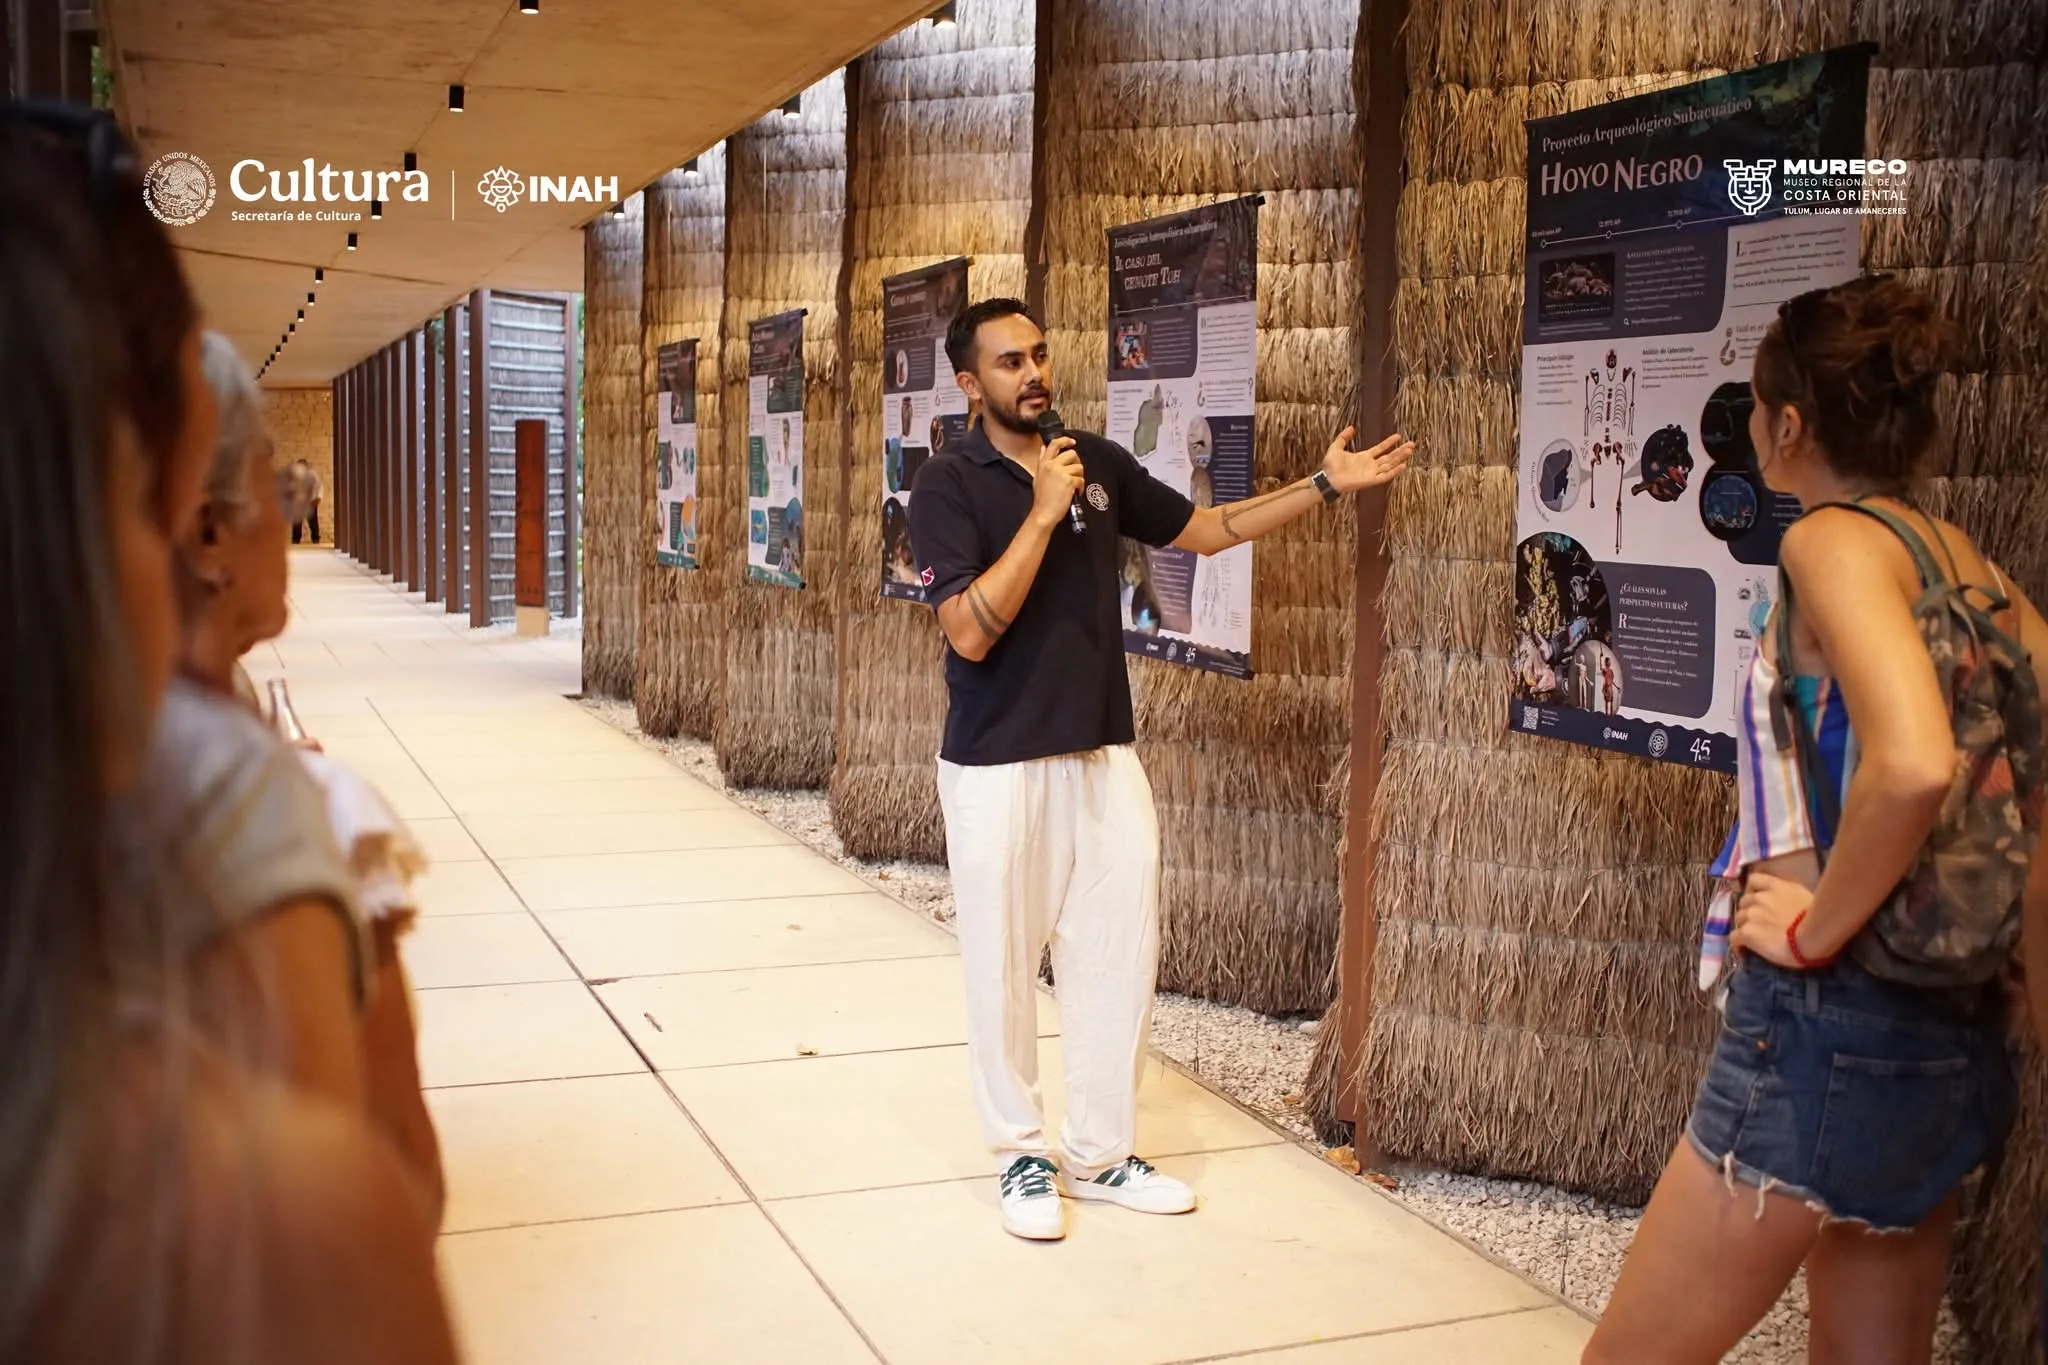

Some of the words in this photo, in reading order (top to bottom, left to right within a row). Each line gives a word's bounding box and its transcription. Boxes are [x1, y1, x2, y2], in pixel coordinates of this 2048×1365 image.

[1542, 134, 1590, 155] Proyecto
[1593, 116, 1672, 145] Arqueológico
[1672, 98, 1752, 127] Subacuático
[1612, 730, 1628, 741] INAH
[1690, 737, 1711, 762] 45
